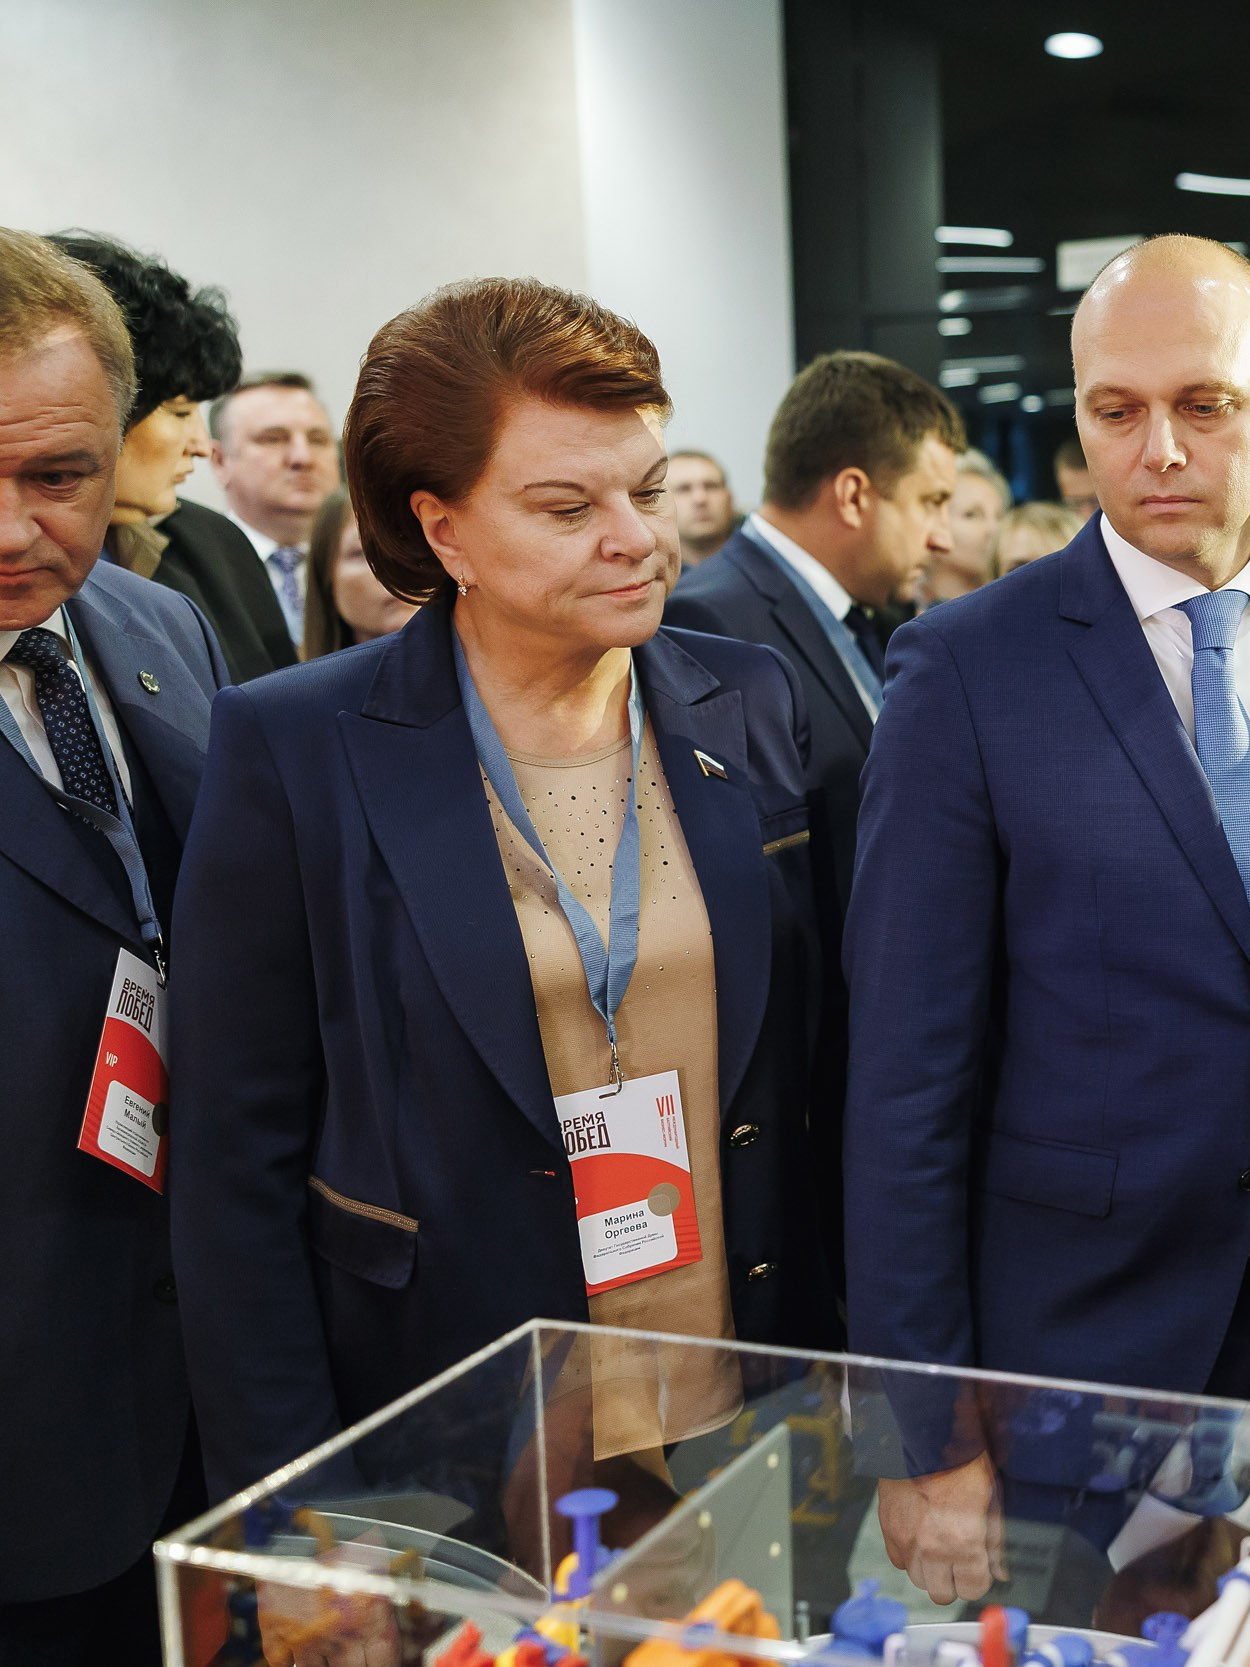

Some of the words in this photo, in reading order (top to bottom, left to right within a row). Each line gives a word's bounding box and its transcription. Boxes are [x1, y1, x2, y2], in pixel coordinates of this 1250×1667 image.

[122, 977, 155, 1007] ВРЕМЯ
[115, 988, 154, 1034] ПОБЕД
[105, 1051, 118, 1067] VIP
[124, 1095, 151, 1118] Евгений
[655, 1094, 675, 1117] VII
[124, 1108, 147, 1129] Малый
[562, 1111, 606, 1132] РЕМЯ
[564, 1123, 611, 1156] ОБЕД
[604, 1210, 645, 1227] Марина
[604, 1221, 648, 1239] Оргеева
